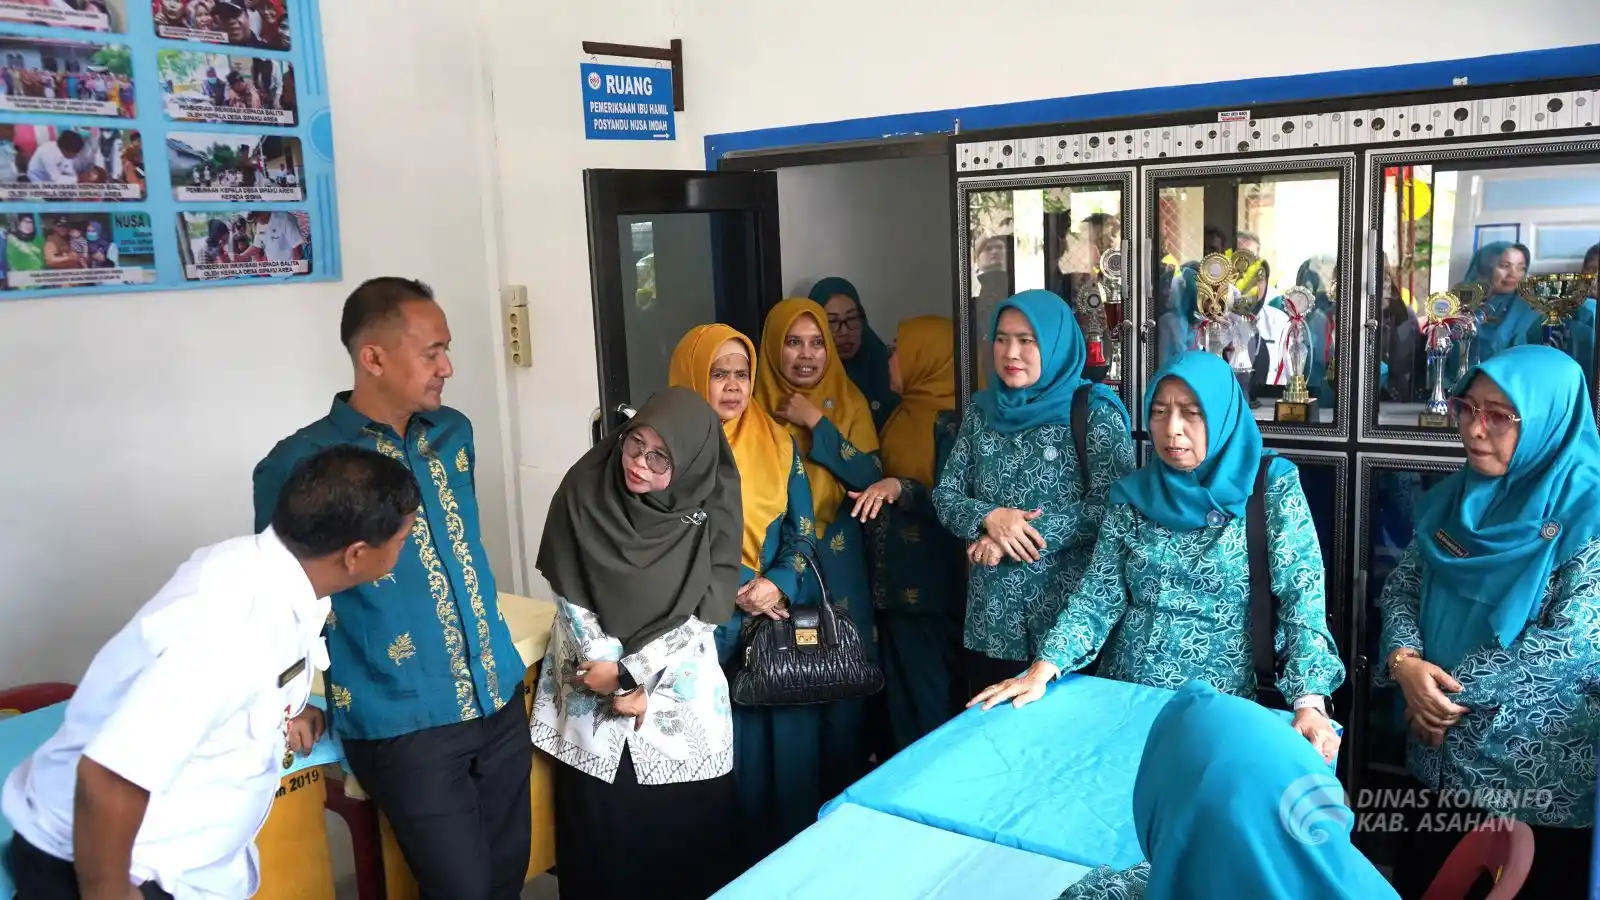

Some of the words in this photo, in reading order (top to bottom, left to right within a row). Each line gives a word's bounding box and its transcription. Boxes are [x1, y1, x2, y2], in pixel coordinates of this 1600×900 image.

[605, 74, 653, 96] RUANG
[589, 101, 636, 114] PEMERIKSAAN
[637, 103, 648, 114] IBU
[649, 104, 669, 115] HAMIL
[593, 118, 629, 131] POSYANDU
[630, 119, 648, 131] NUSA
[648, 120, 668, 132] INDAH
[115, 214, 145, 228] NUSA
[289, 768, 320, 792] 2019
